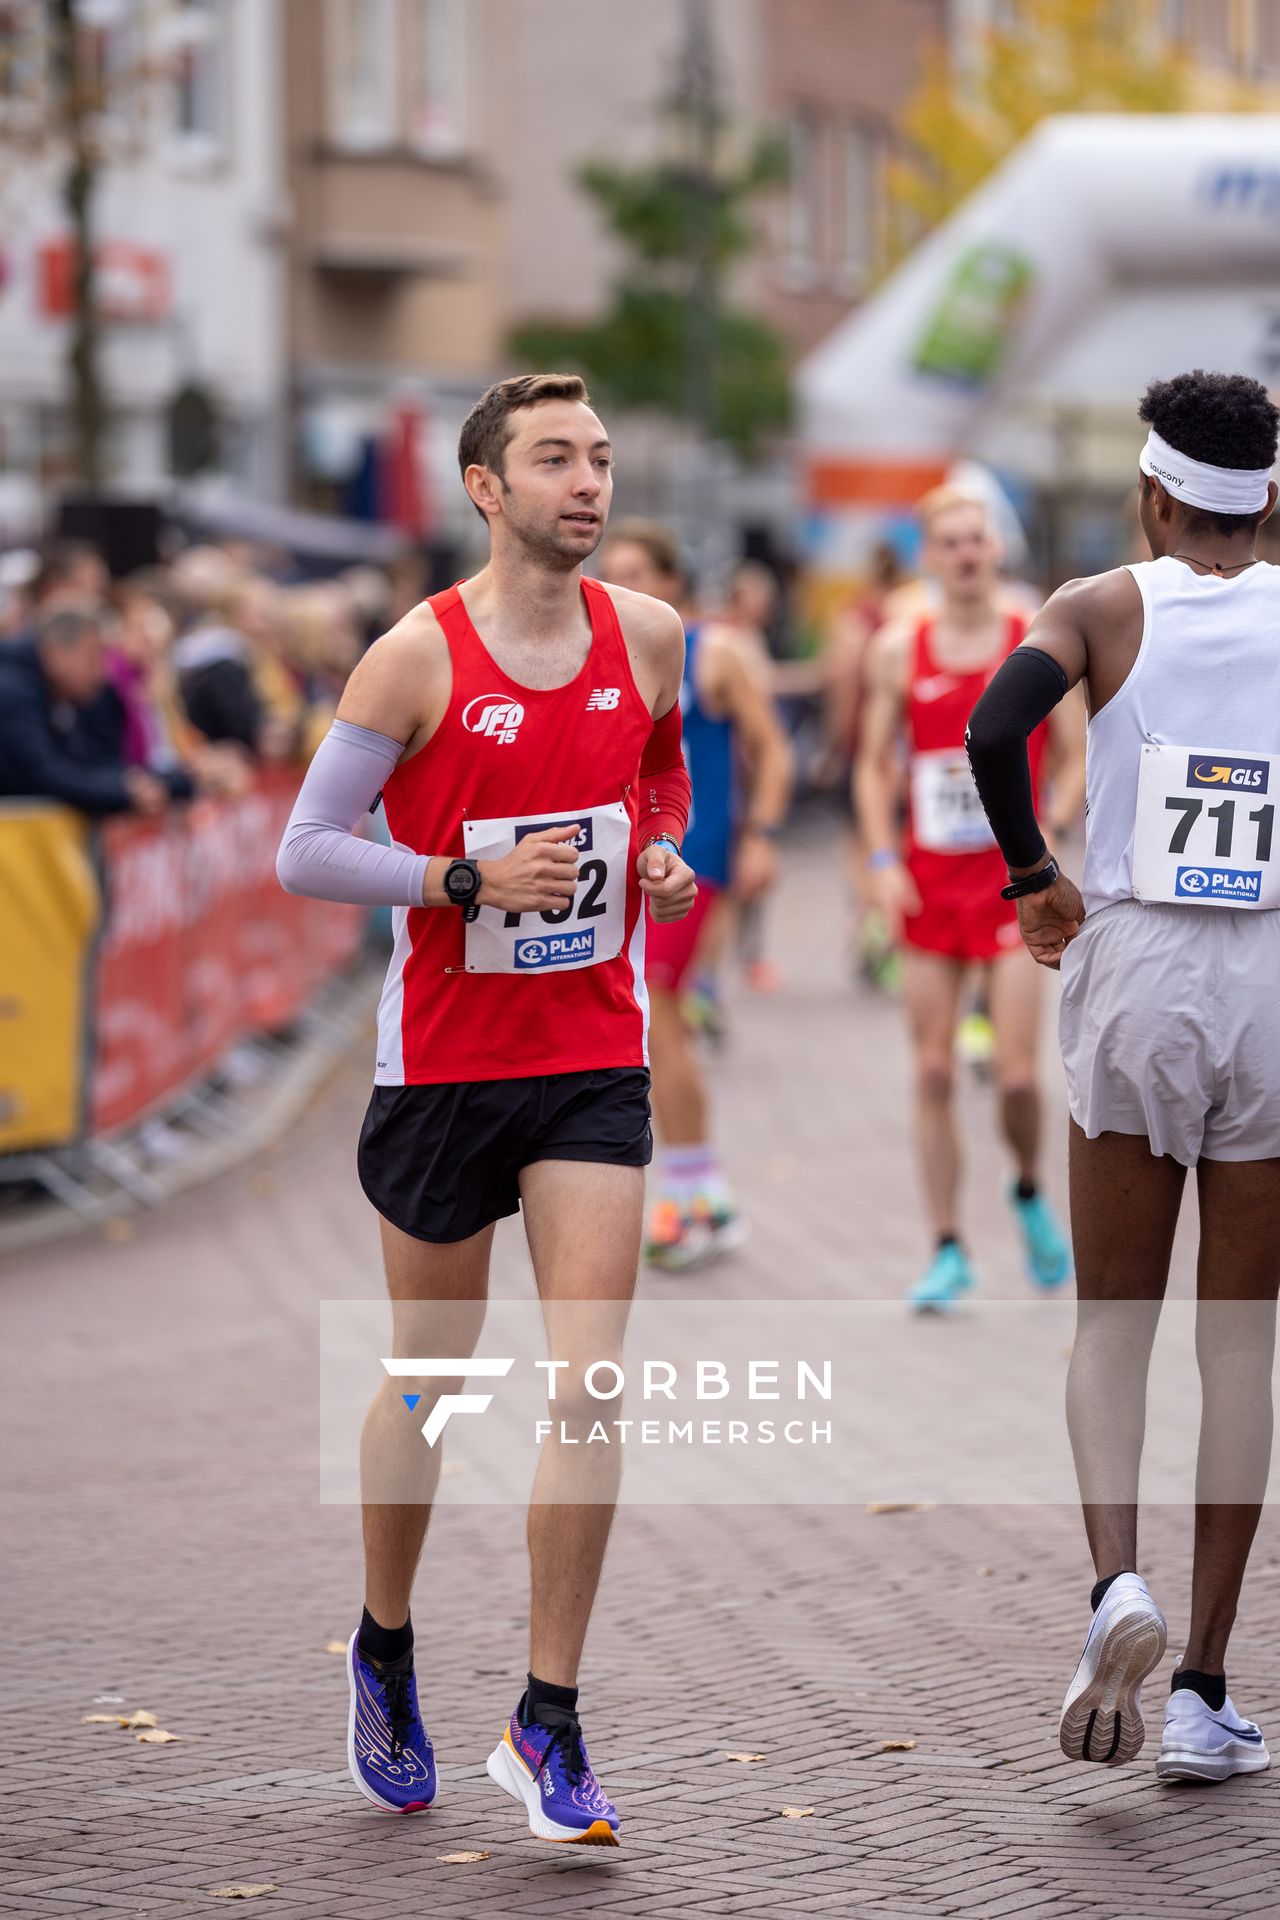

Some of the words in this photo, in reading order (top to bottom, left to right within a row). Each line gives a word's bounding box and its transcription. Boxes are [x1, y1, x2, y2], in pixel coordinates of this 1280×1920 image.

[1149, 462, 1185, 487] saucony
[586, 688, 620, 711] NB
[1231, 768, 1263, 787] GLS
[1165, 797, 1275, 862] 711
[1211, 873, 1258, 891] PLAN
[1211, 888, 1256, 898] INTERNATIONAL
[550, 934, 592, 954] PLAN
[550, 949, 592, 962] INTERNATIONAL
